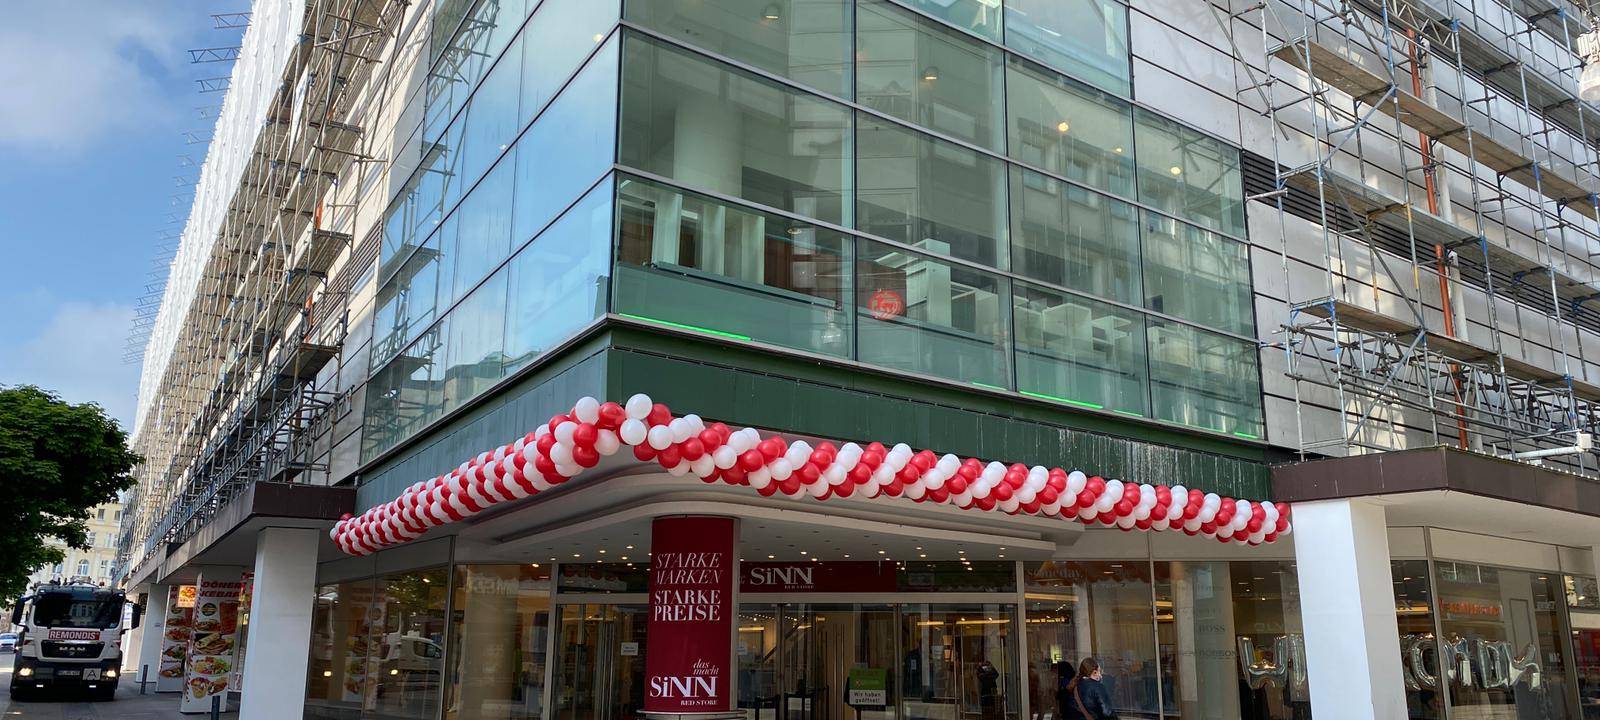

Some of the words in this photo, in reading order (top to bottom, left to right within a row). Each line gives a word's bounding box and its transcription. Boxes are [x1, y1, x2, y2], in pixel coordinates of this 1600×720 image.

[656, 552, 722, 568] STARKE
[656, 569, 723, 585] MARKEN
[654, 589, 721, 605] STARKE
[654, 604, 721, 622] PREISE
[50, 630, 96, 640] REMONDIS
[692, 658, 710, 669] das
[692, 665, 719, 675] macht
[649, 675, 719, 698] SiNN
